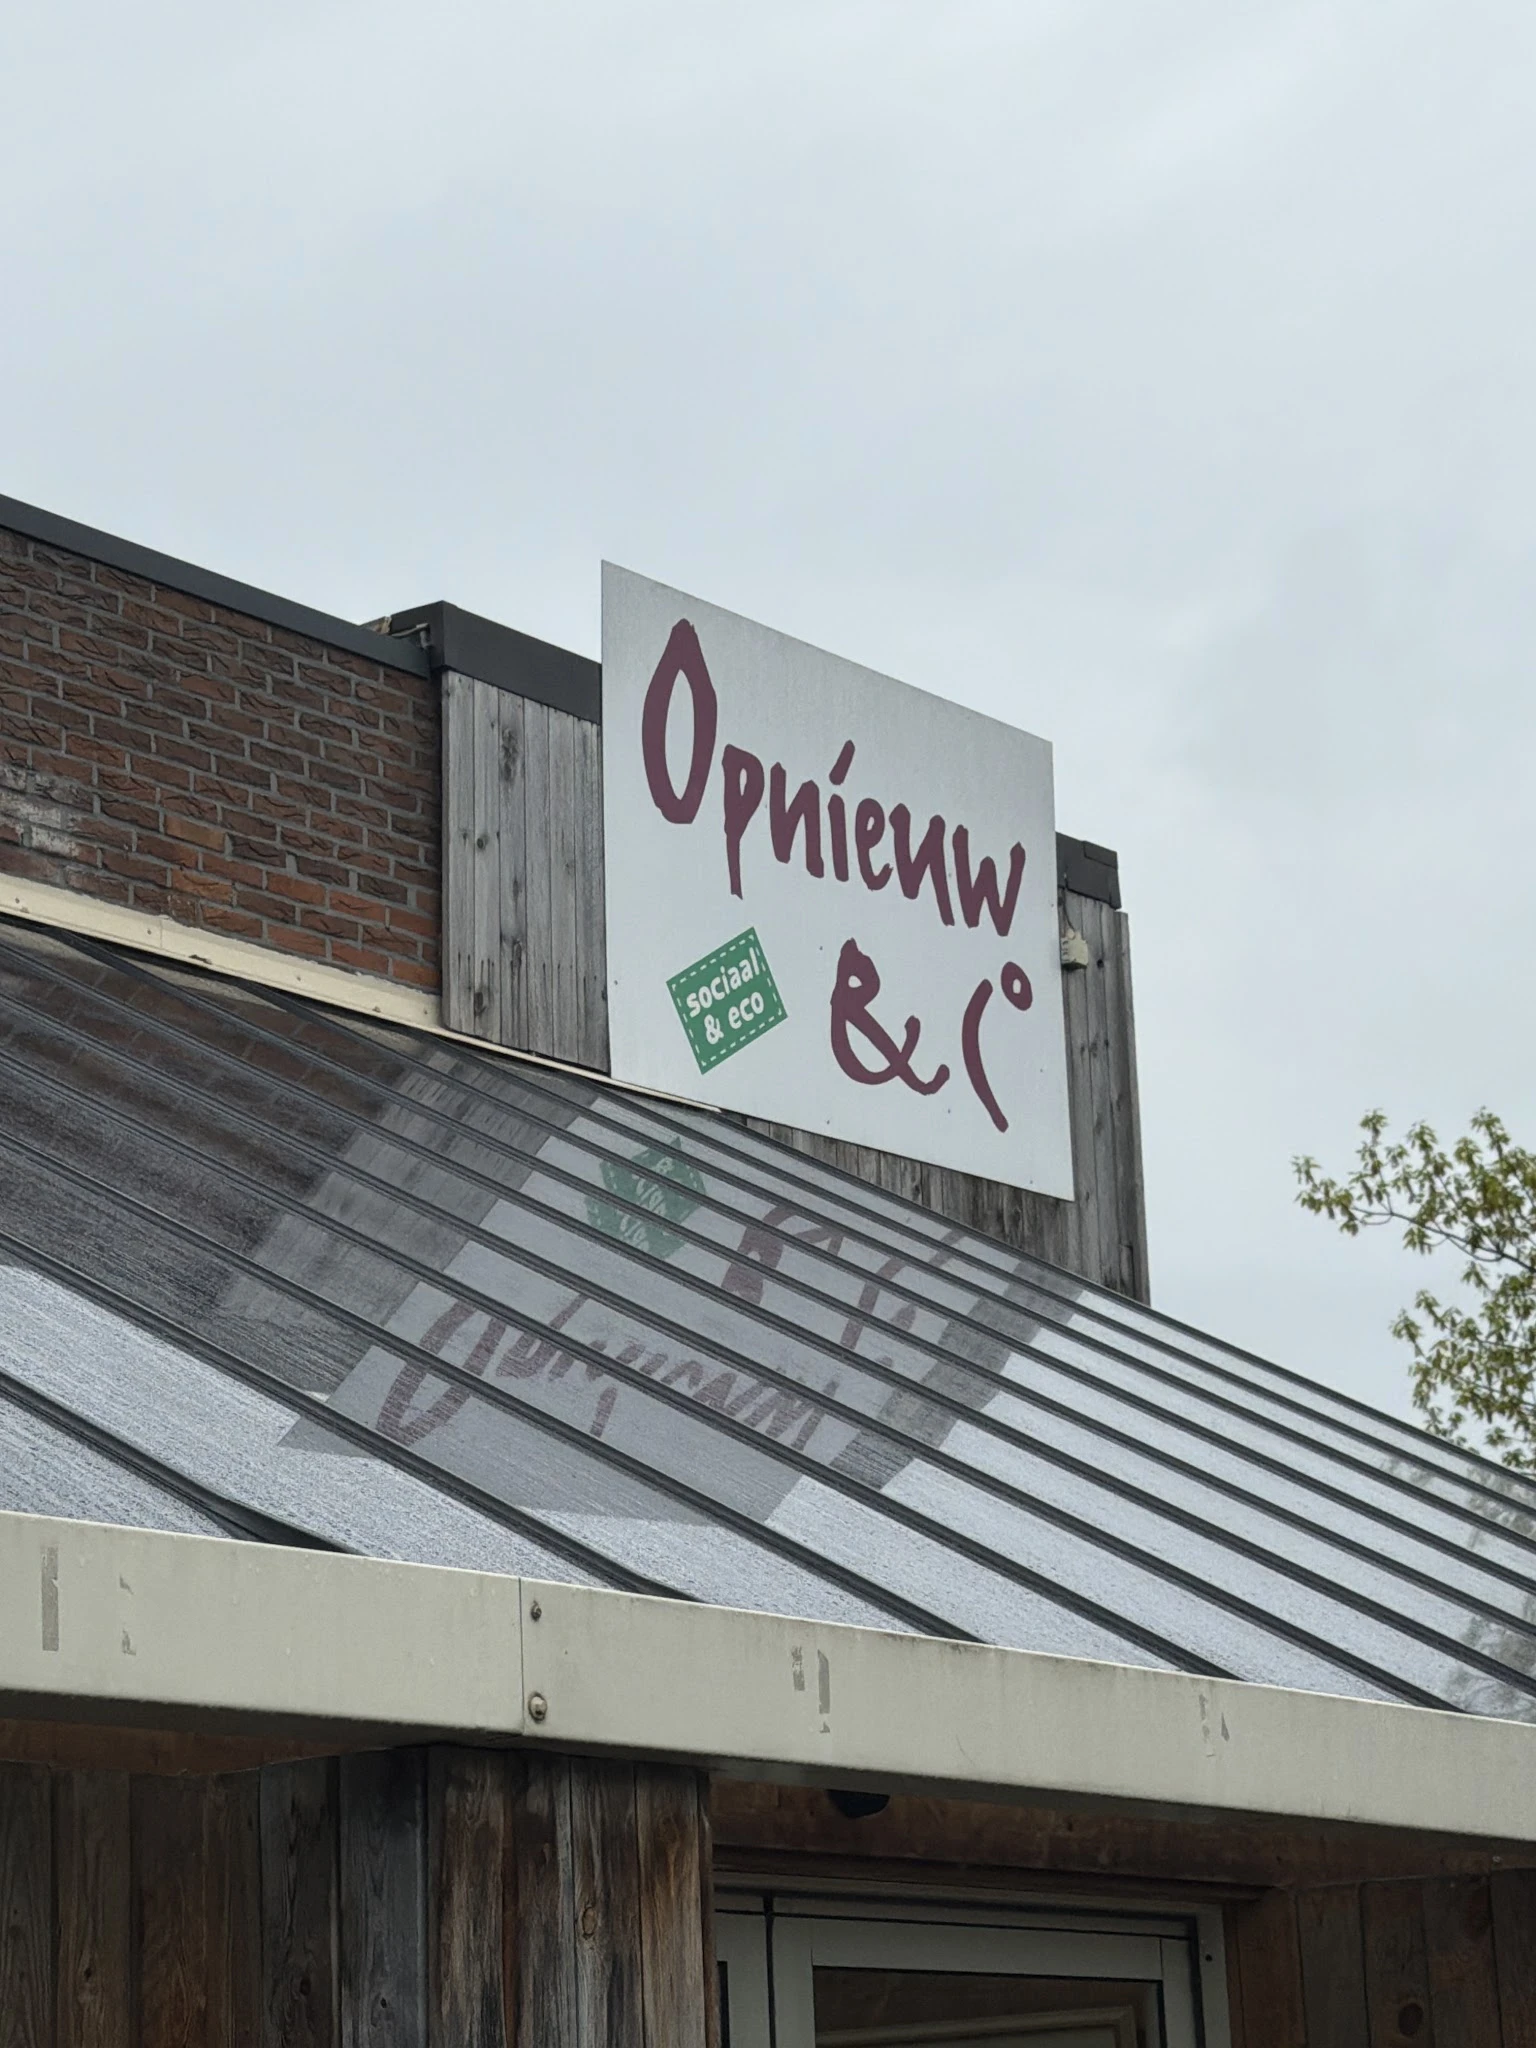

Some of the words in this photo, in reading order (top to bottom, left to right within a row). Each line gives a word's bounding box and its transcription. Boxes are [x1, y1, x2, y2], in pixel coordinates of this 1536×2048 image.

[685, 946, 761, 1019] sociaal
[703, 1014, 725, 1045] &
[728, 991, 765, 1030] eco
[829, 937, 951, 1096] &
